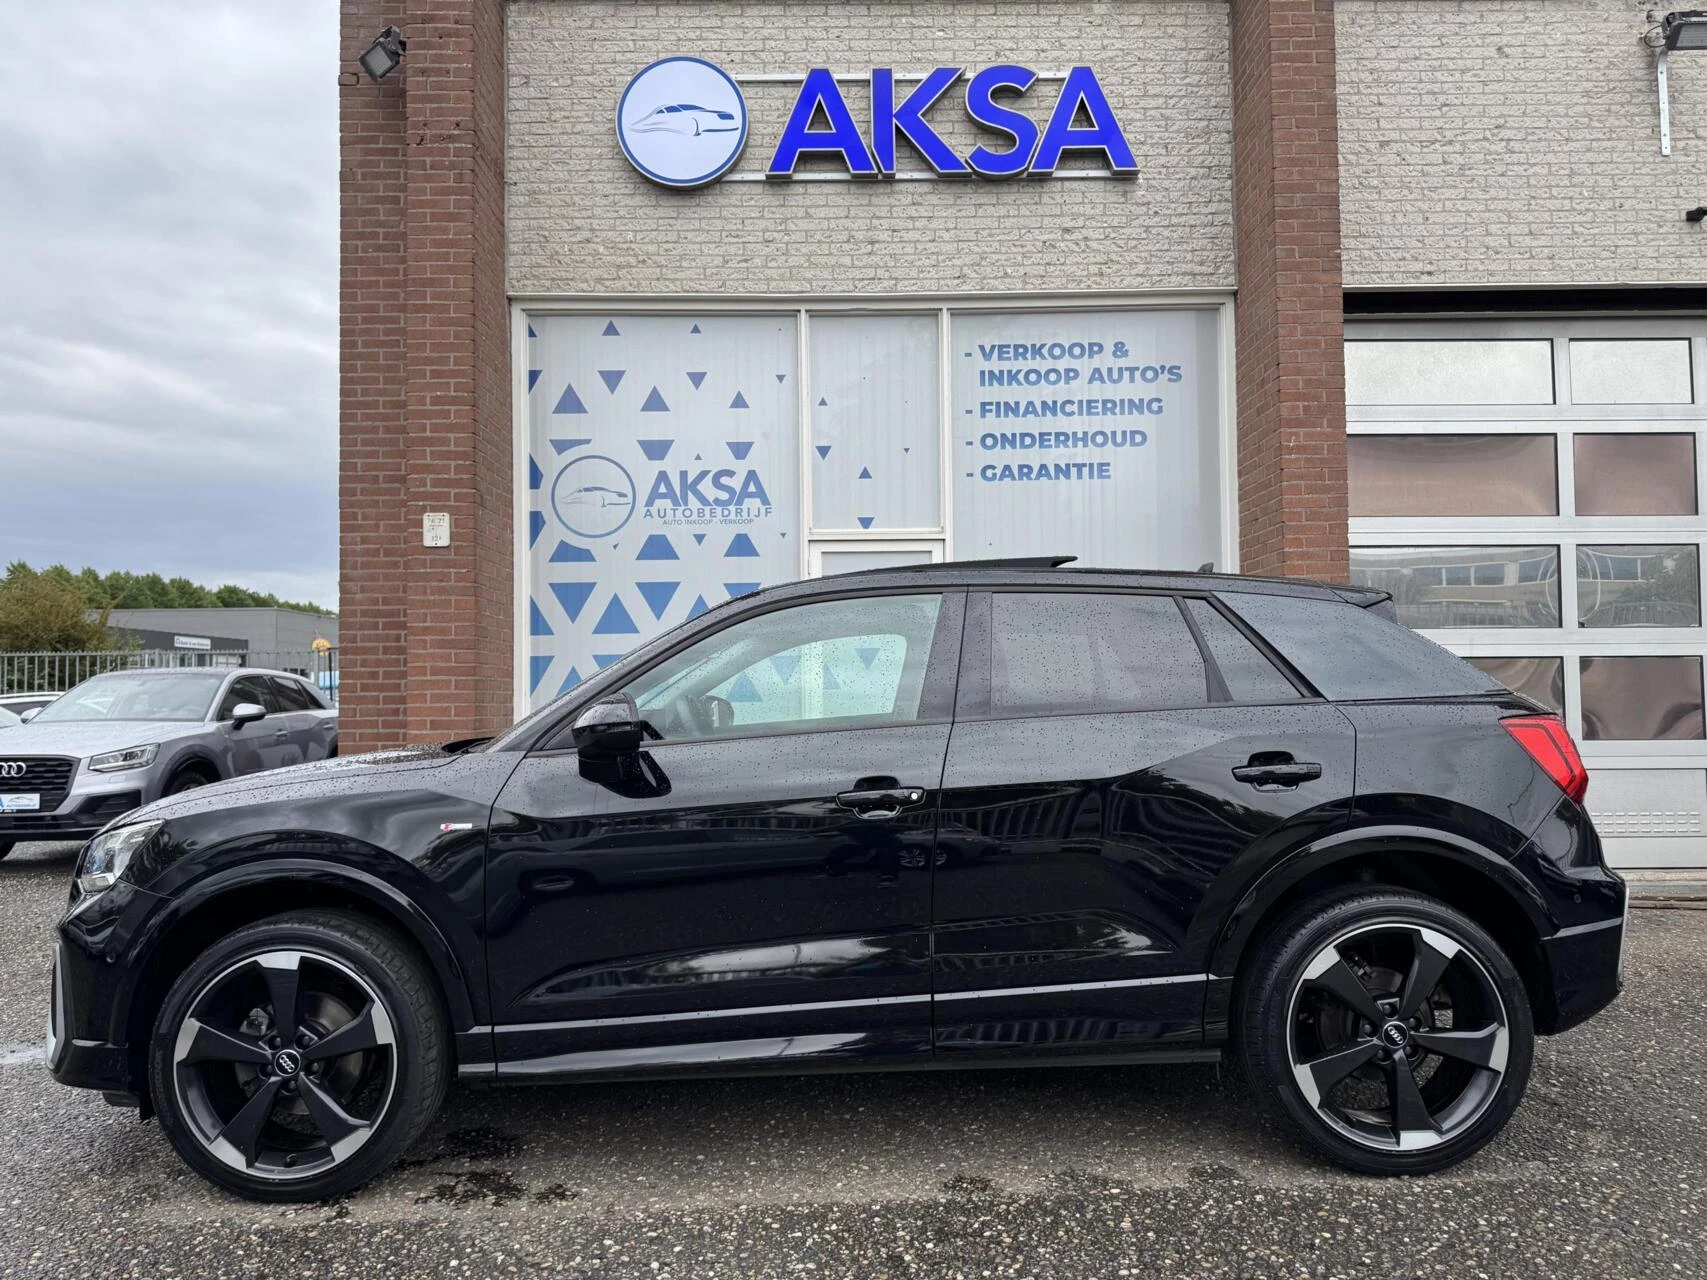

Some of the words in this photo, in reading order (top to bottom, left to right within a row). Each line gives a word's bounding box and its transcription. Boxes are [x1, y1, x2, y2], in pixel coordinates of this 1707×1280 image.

[765, 64, 1140, 180] AKSA
[977, 341, 1105, 362] VERKOOP
[1111, 341, 1130, 359] &
[978, 367, 1080, 387] INKOOP
[1087, 364, 1183, 385] AUTO'S
[979, 397, 1164, 419] FINANCIERING
[979, 430, 1148, 451] ONDERHOUD
[980, 462, 1112, 482] GARANTIE
[643, 468, 772, 507] AKSA
[643, 507, 773, 519] AUTOBEDRIJF
[719, 518, 754, 526] VERKOOP
